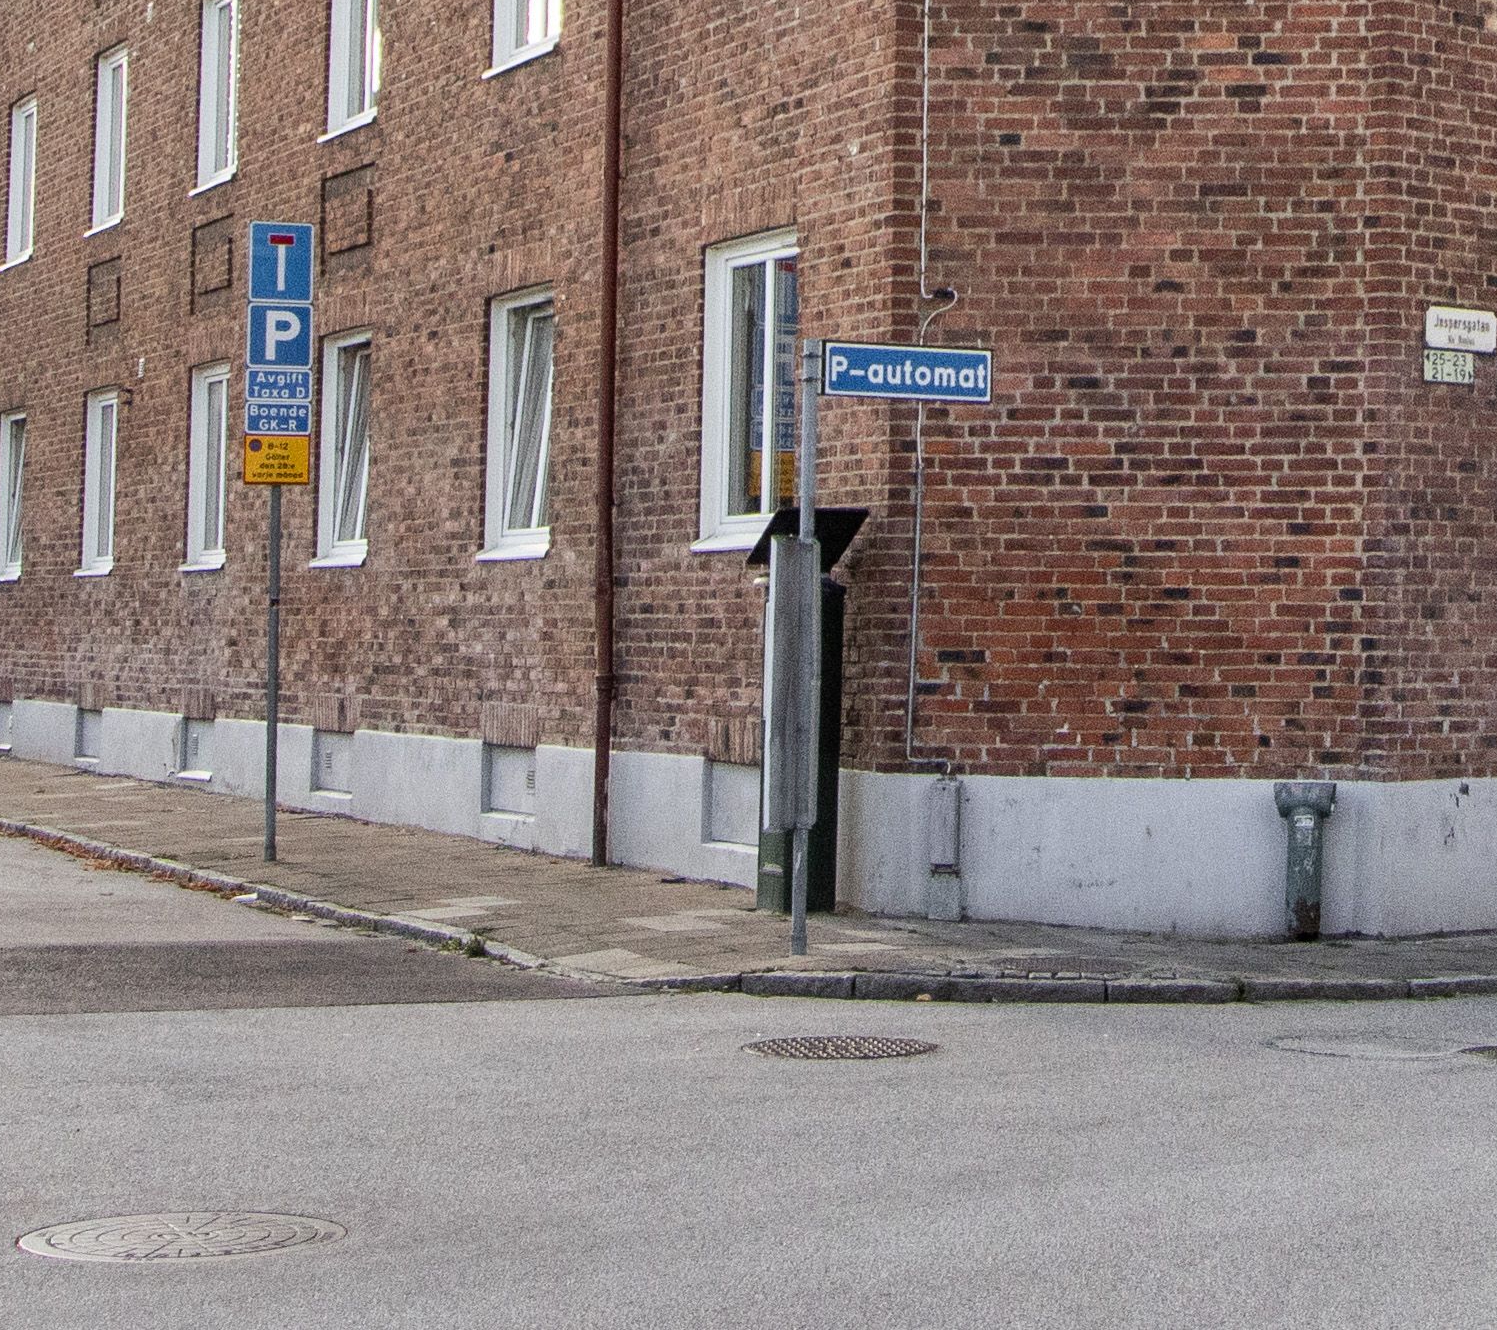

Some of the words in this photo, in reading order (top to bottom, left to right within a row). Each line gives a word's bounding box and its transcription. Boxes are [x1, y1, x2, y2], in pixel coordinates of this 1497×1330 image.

[1434, 314, 1490, 333] Jespersgatan
[265, 310, 301, 360] P
[1431, 352, 1467, 367] 25-23
[256, 372, 303, 386] Avgift
[831, 355, 986, 389] P-automat
[1431, 367, 1467, 381] 21-19
[252, 386, 289, 397] Taxa
[296, 387, 305, 398] D
[250, 405, 307, 417] Boende
[259, 419, 297, 431] GK-R
